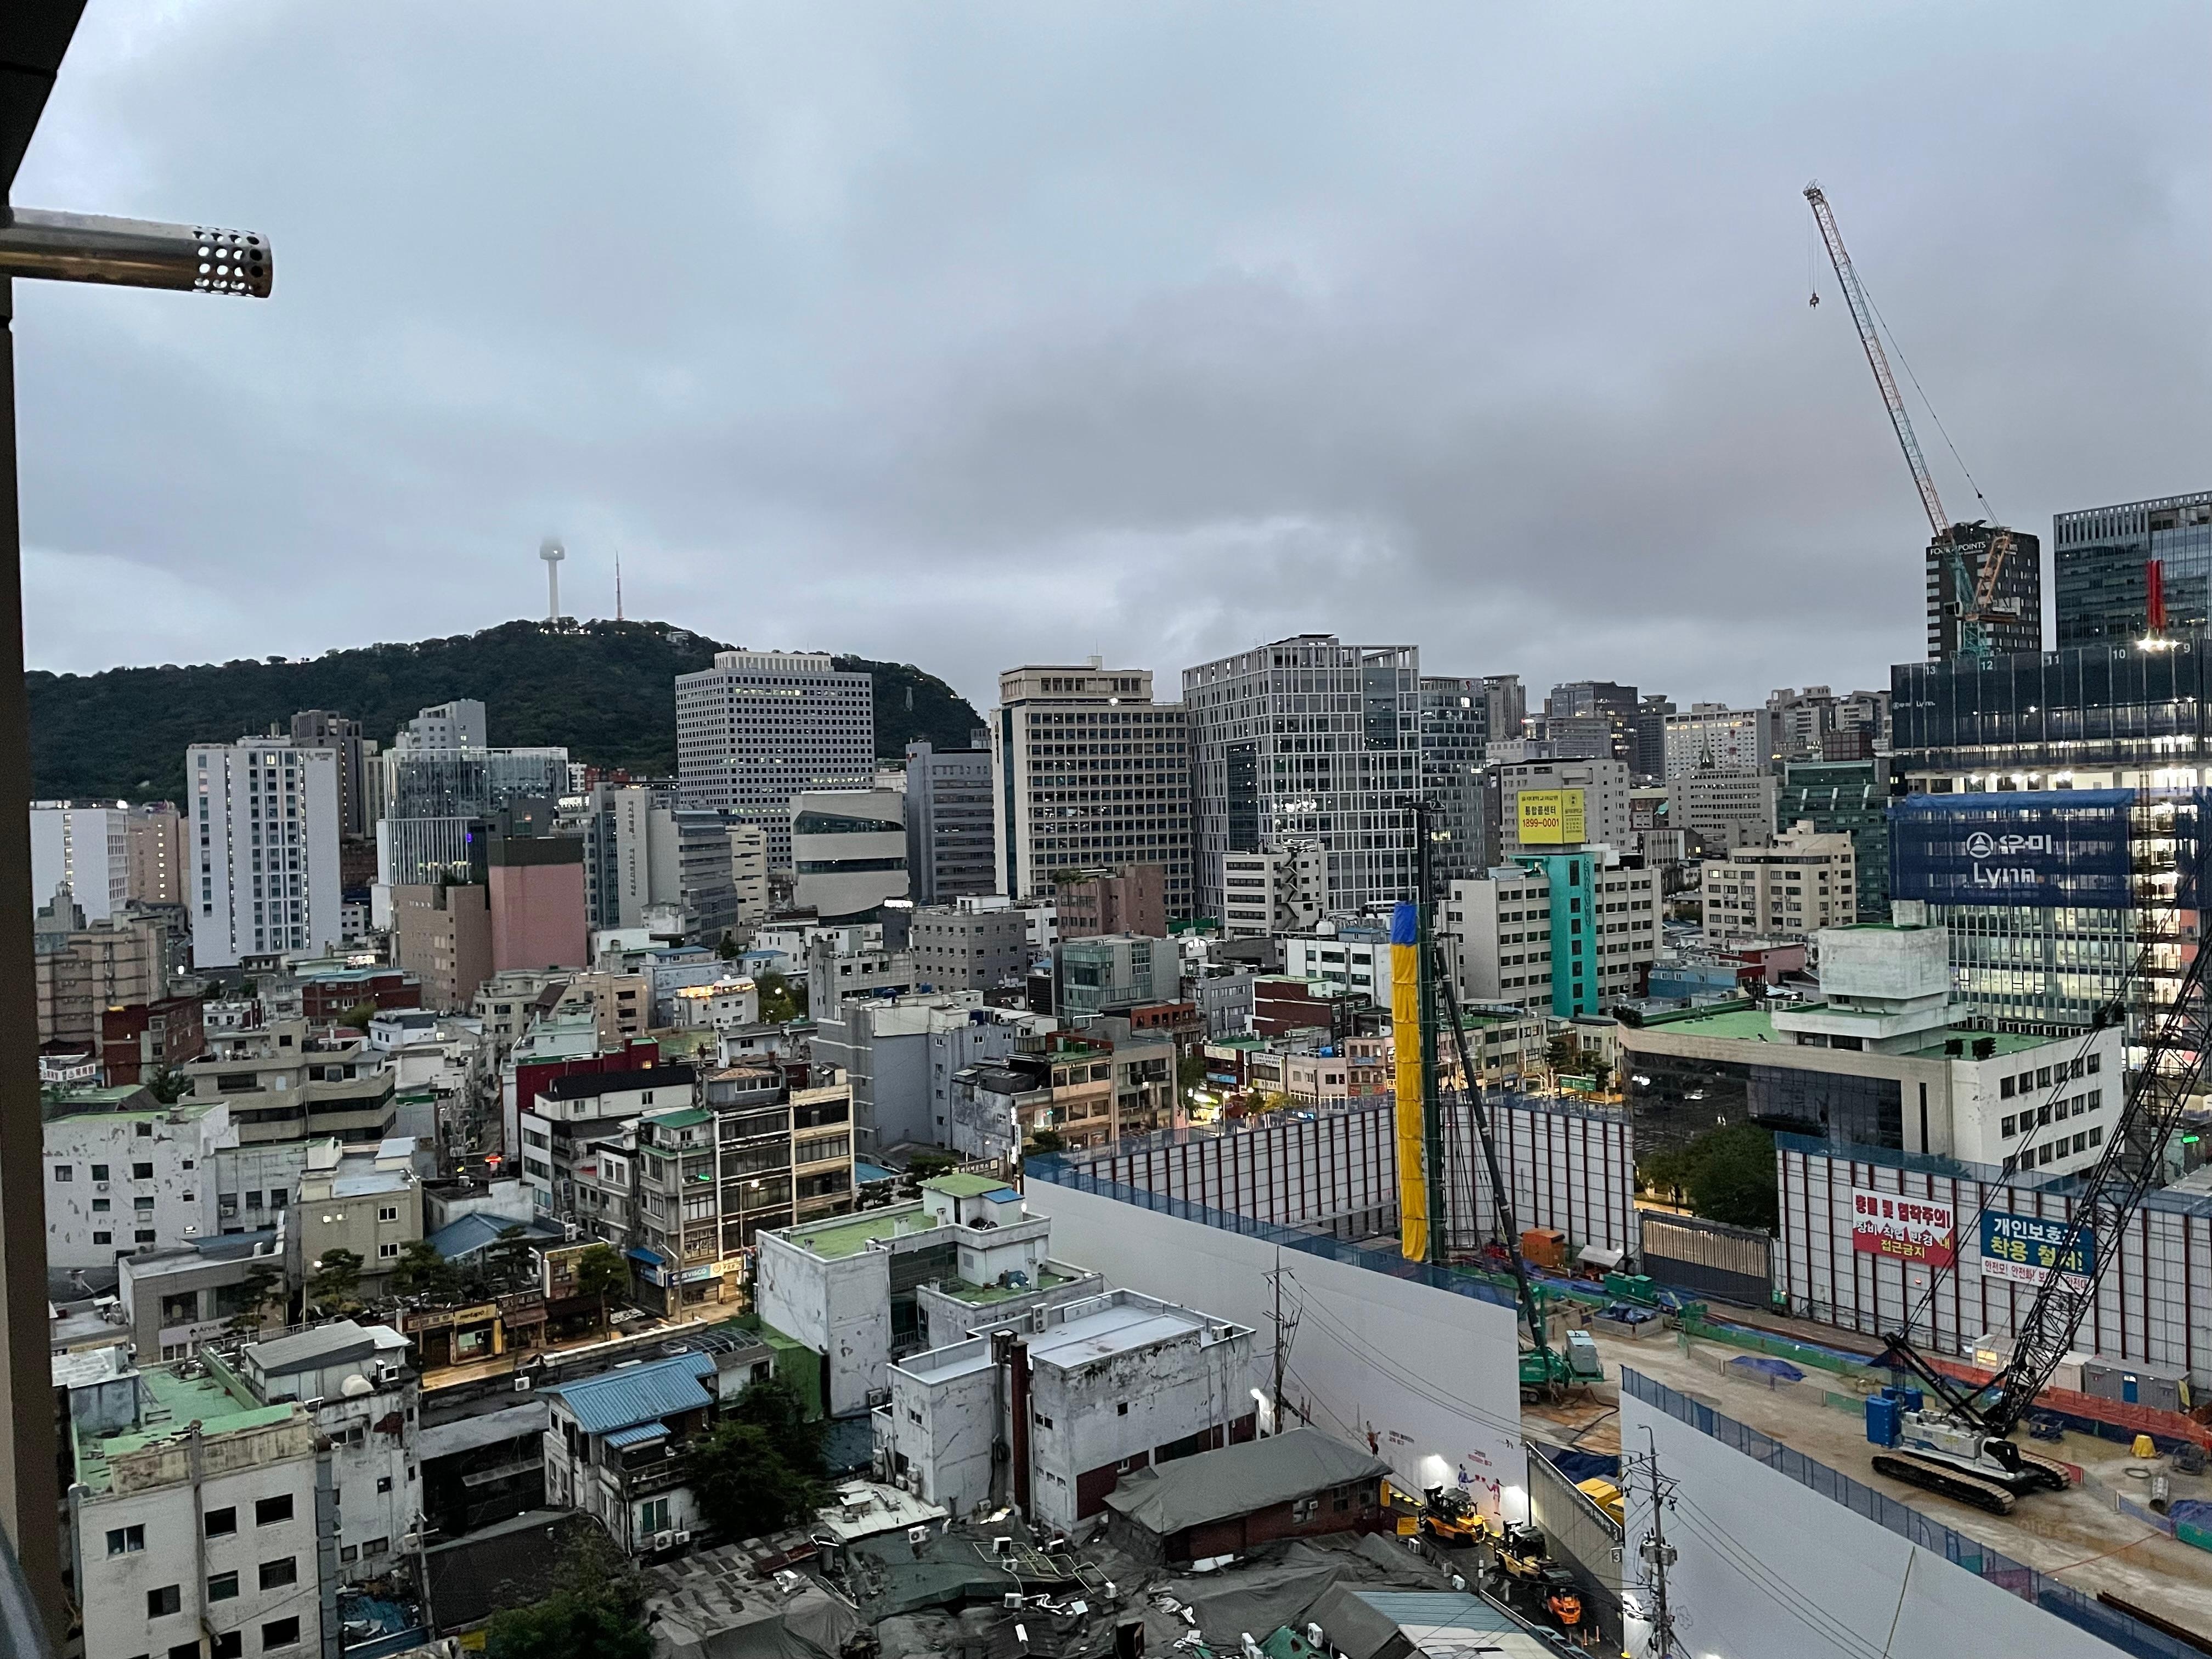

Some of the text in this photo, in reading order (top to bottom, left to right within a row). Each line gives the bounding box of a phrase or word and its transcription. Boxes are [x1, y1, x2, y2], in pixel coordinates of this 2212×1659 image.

[1958, 541, 1986, 551] POINTS
[2113, 649, 2126, 659] 10
[2183, 644, 2191, 653] 9
[2047, 654, 2060, 665] 11
[1925, 665, 1937, 675] 13
[1980, 660, 1994, 671] 12
[1525, 805, 1556, 815] 통합콜센터
[1522, 818, 1559, 827] 1899-0001
[1999, 834, 2051, 854] 우미
[1973, 862, 2035, 889] Lynn
[1855, 1194, 1951, 1229] 충돌 및 협착주의!
[1856, 1220, 1950, 1250] 장비 작업 반경 내
[1881, 1239, 1925, 1259] 접근금지
[1991, 1236, 2028, 1262] 착용
[1985, 1260, 2008, 1276] 안전모!
[2011, 1266, 2034, 1282] 안전화!
[1613, 1552, 1620, 1562] 3
